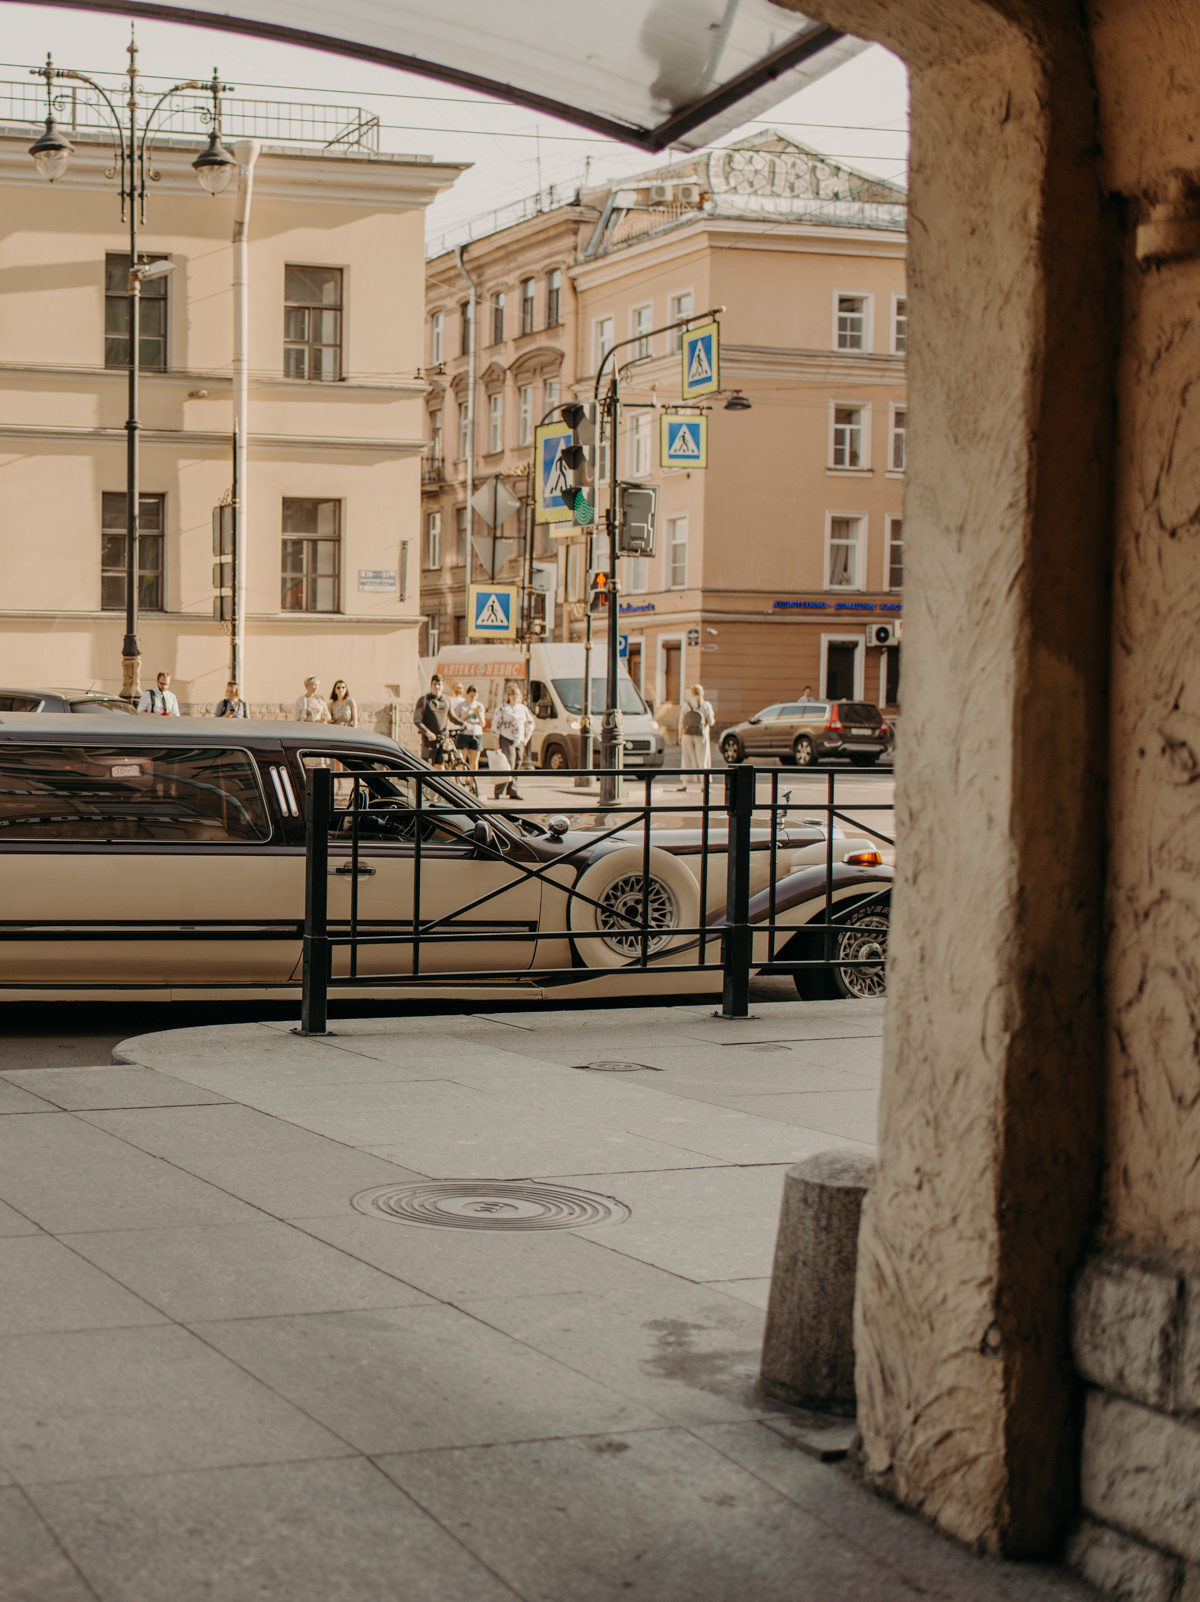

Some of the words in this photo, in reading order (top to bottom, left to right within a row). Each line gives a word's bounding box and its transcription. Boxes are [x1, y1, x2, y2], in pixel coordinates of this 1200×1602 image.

[773, 601, 828, 609] АУДИОТЕХНИКА
[835, 602, 877, 610] ДОМАШНИЕ
[443, 664, 475, 675] АПТЕКА
[486, 664, 519, 675] НЕВИС
